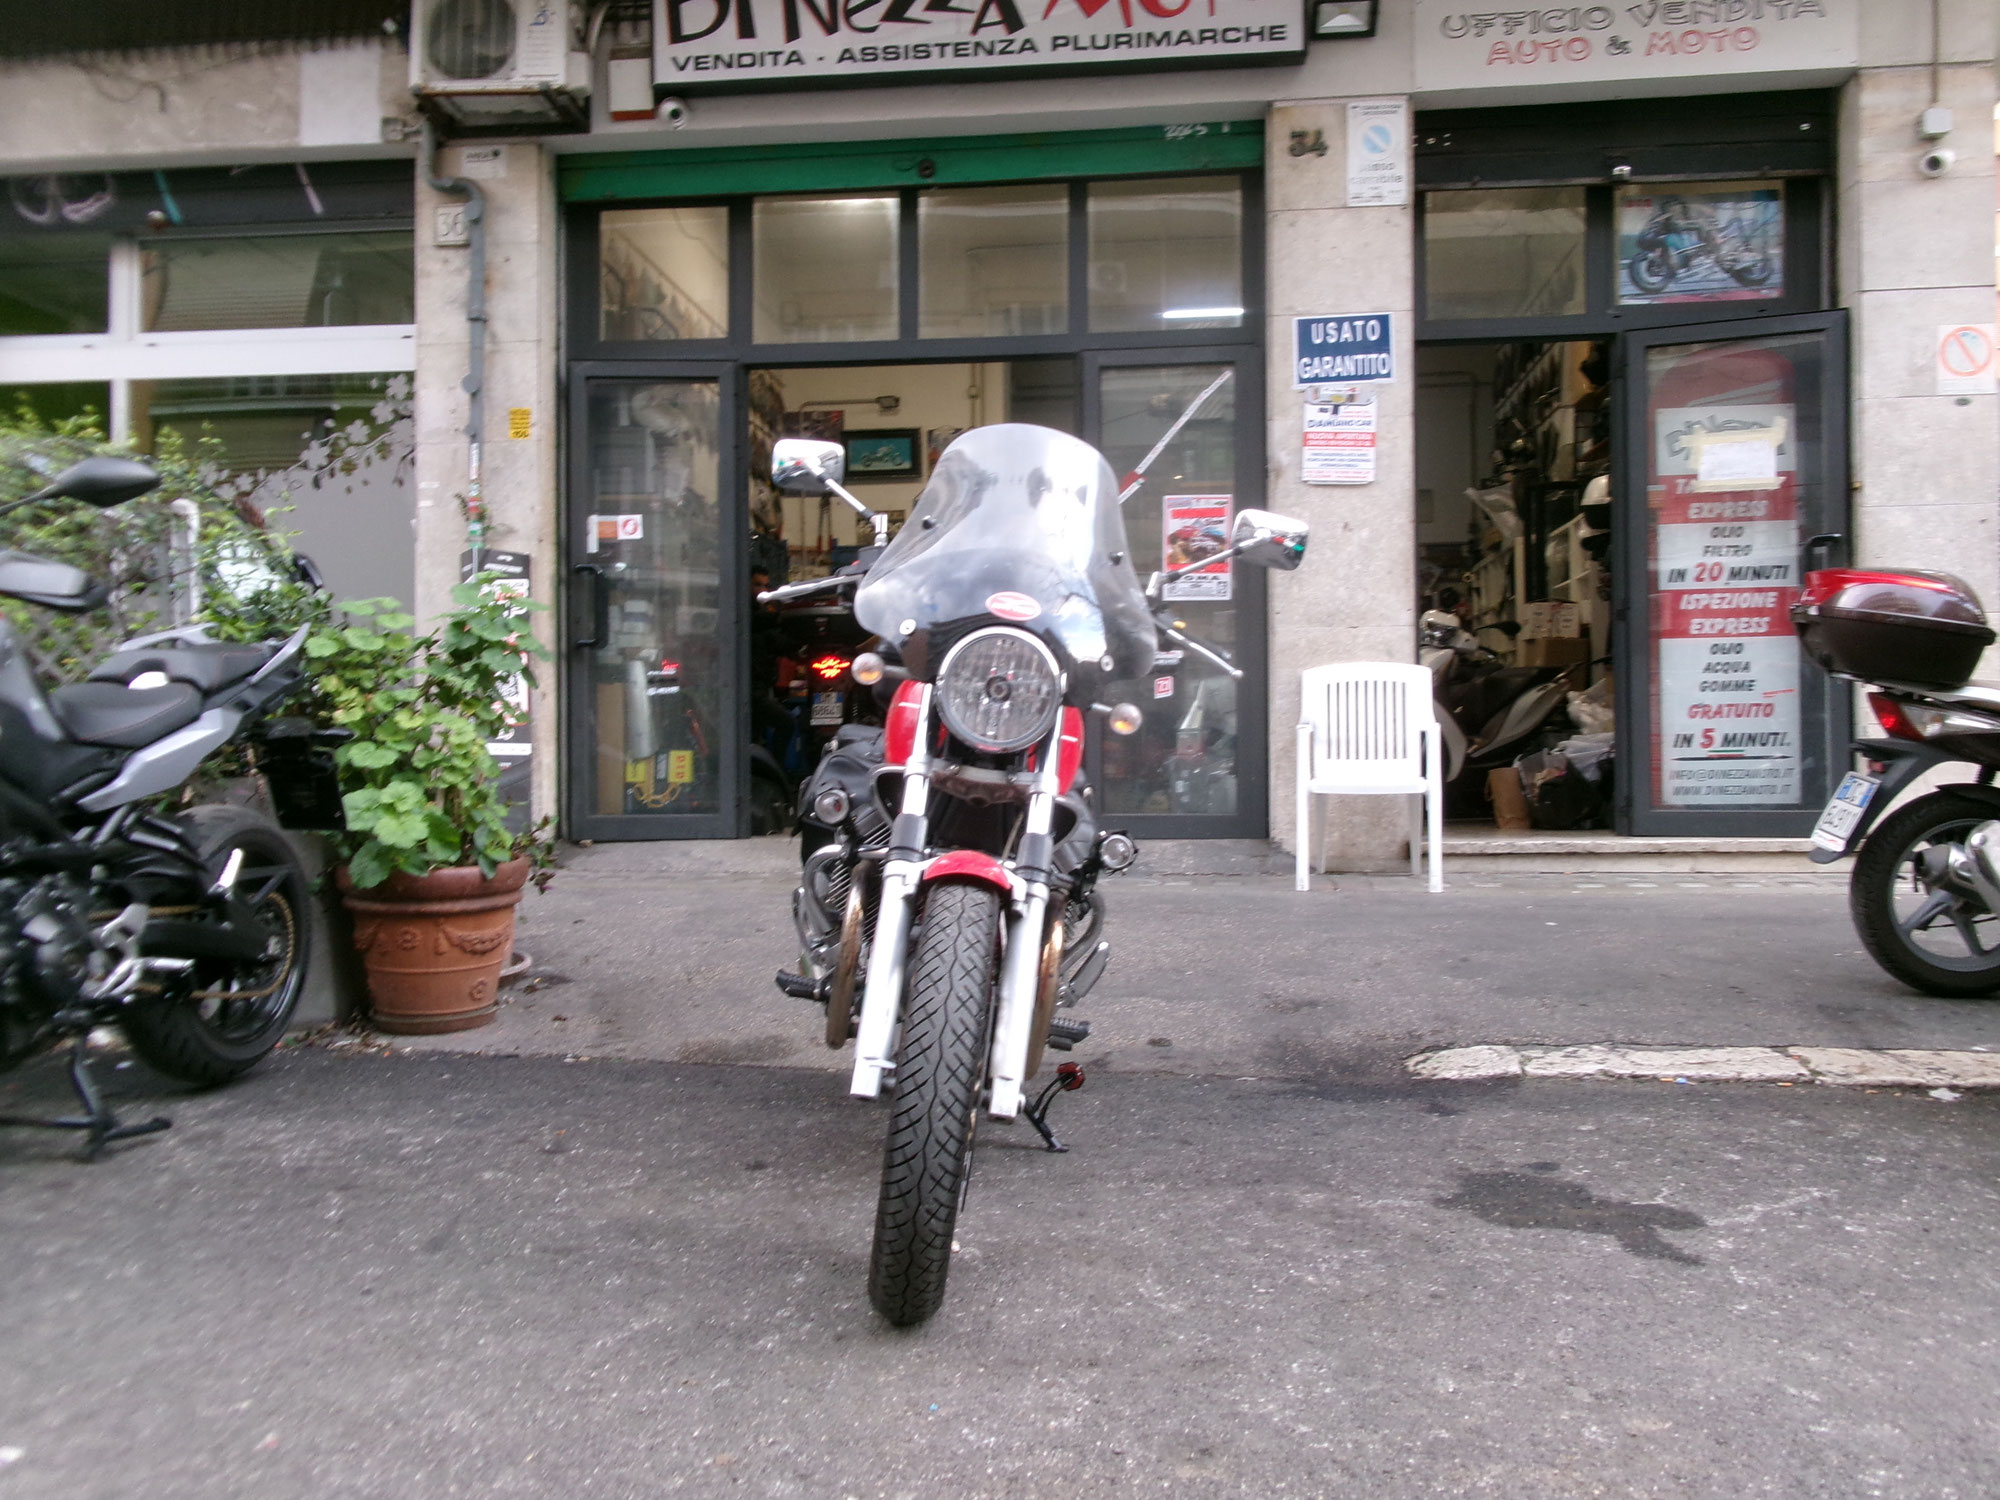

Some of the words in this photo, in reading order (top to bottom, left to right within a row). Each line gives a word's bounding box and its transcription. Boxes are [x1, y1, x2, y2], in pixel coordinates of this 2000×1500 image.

[1439, 6, 1616, 39] UFFICIO
[1627, 0, 1826, 28] VENDITA
[672, 50, 805, 72] VENDITA
[837, 38, 1039, 64] ASSISTENZA
[1052, 24, 1288, 51] PLURIMARCHE
[1486, 36, 1593, 66] AUTO
[1605, 34, 1632, 56] &
[1644, 26, 1761, 56] MOTO
[1311, 319, 1381, 345] USATO
[1299, 352, 1392, 379] GARANTITO
[1688, 501, 1769, 519] EXPRESS
[1710, 526, 1745, 539] OLIO
[1702, 544, 1752, 557] FILTRO
[1667, 568, 1688, 583] IN
[1693, 561, 1725, 583] 20
[1726, 564, 1790, 582] MINUTI
[1679, 591, 1779, 610] ISPEZIONE
[1688, 616, 1771, 635] EXPRESS
[1710, 642, 1744, 656] OLIO
[1702, 660, 1752, 674] ACQUA
[1699, 679, 1757, 692] GOMME
[1687, 702, 1775, 719] GRATUITO
[1672, 733, 1695, 748] IN
[1700, 728, 1716, 749] 5
